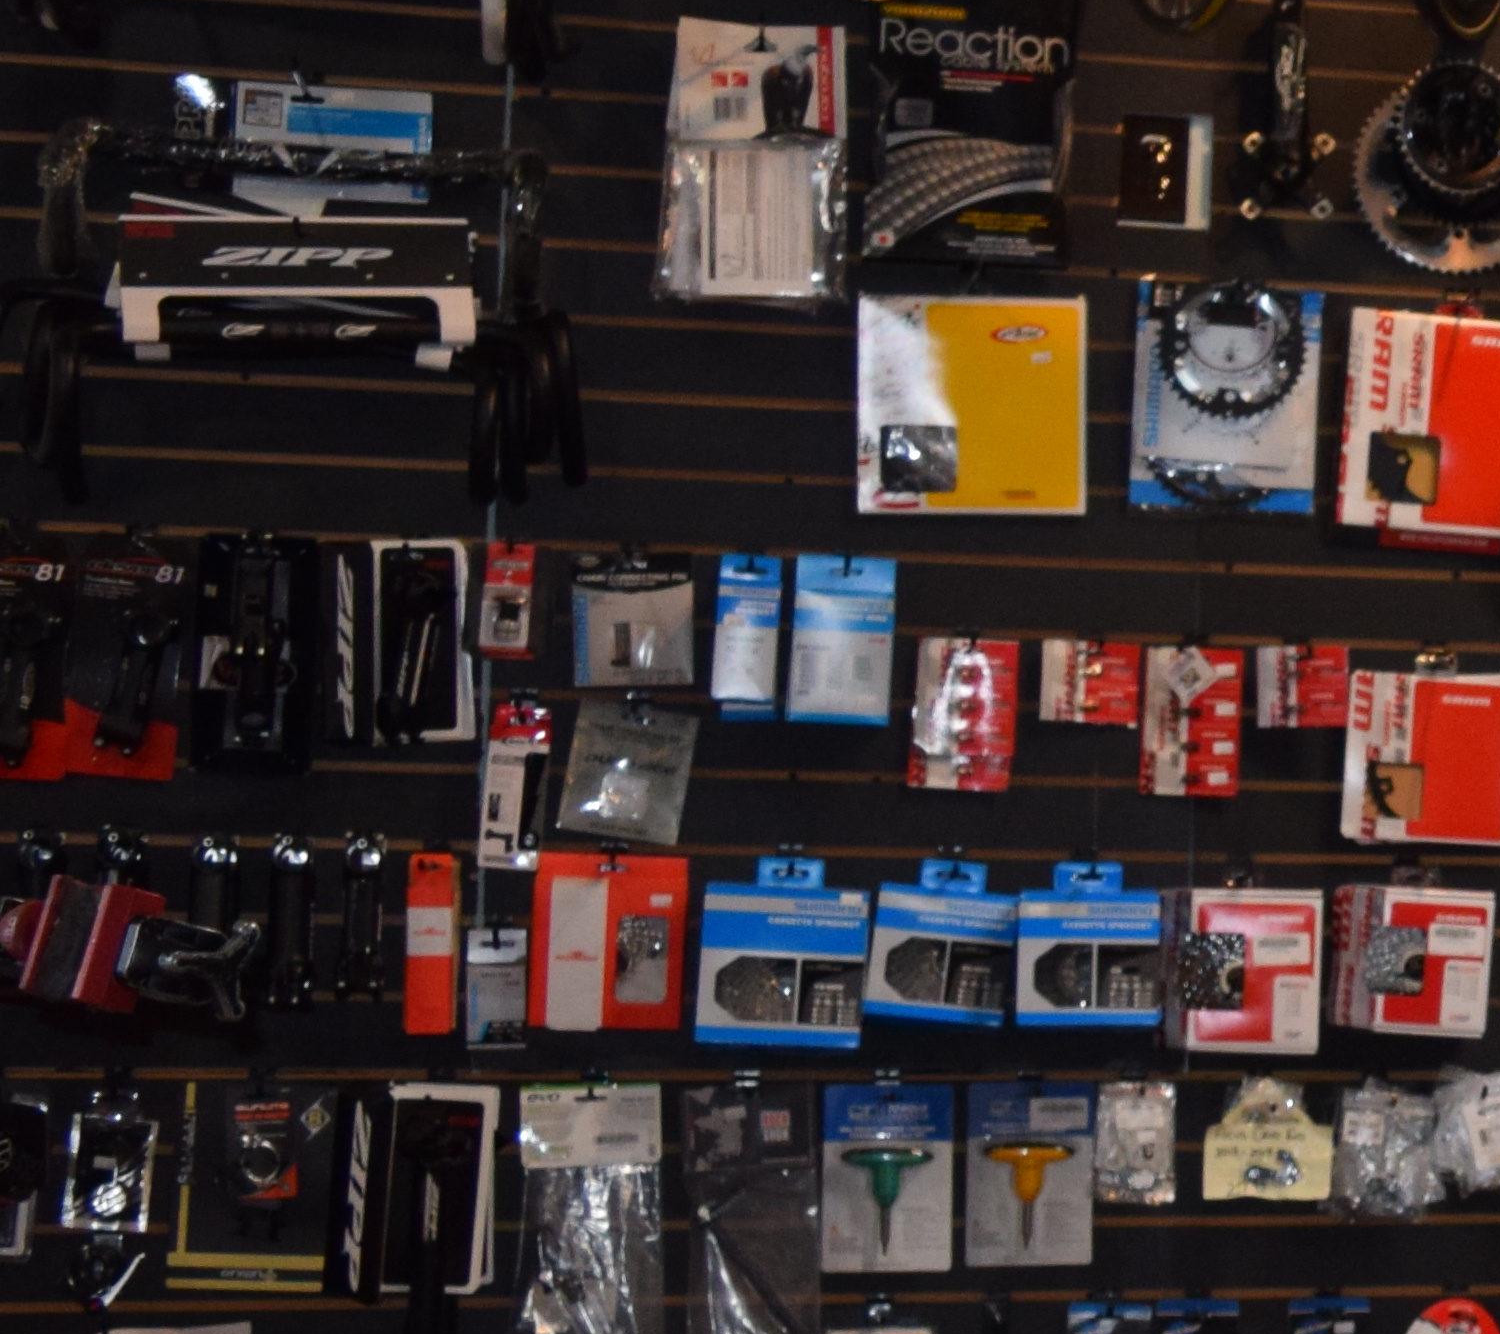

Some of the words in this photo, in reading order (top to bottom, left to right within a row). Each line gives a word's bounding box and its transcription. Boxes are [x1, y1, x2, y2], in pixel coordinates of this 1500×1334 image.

[201, 246, 395, 268] ZIPP
[35, 562, 66, 584] 81
[155, 563, 186, 585] 81
[344, 1099, 371, 1293] ZIPP
